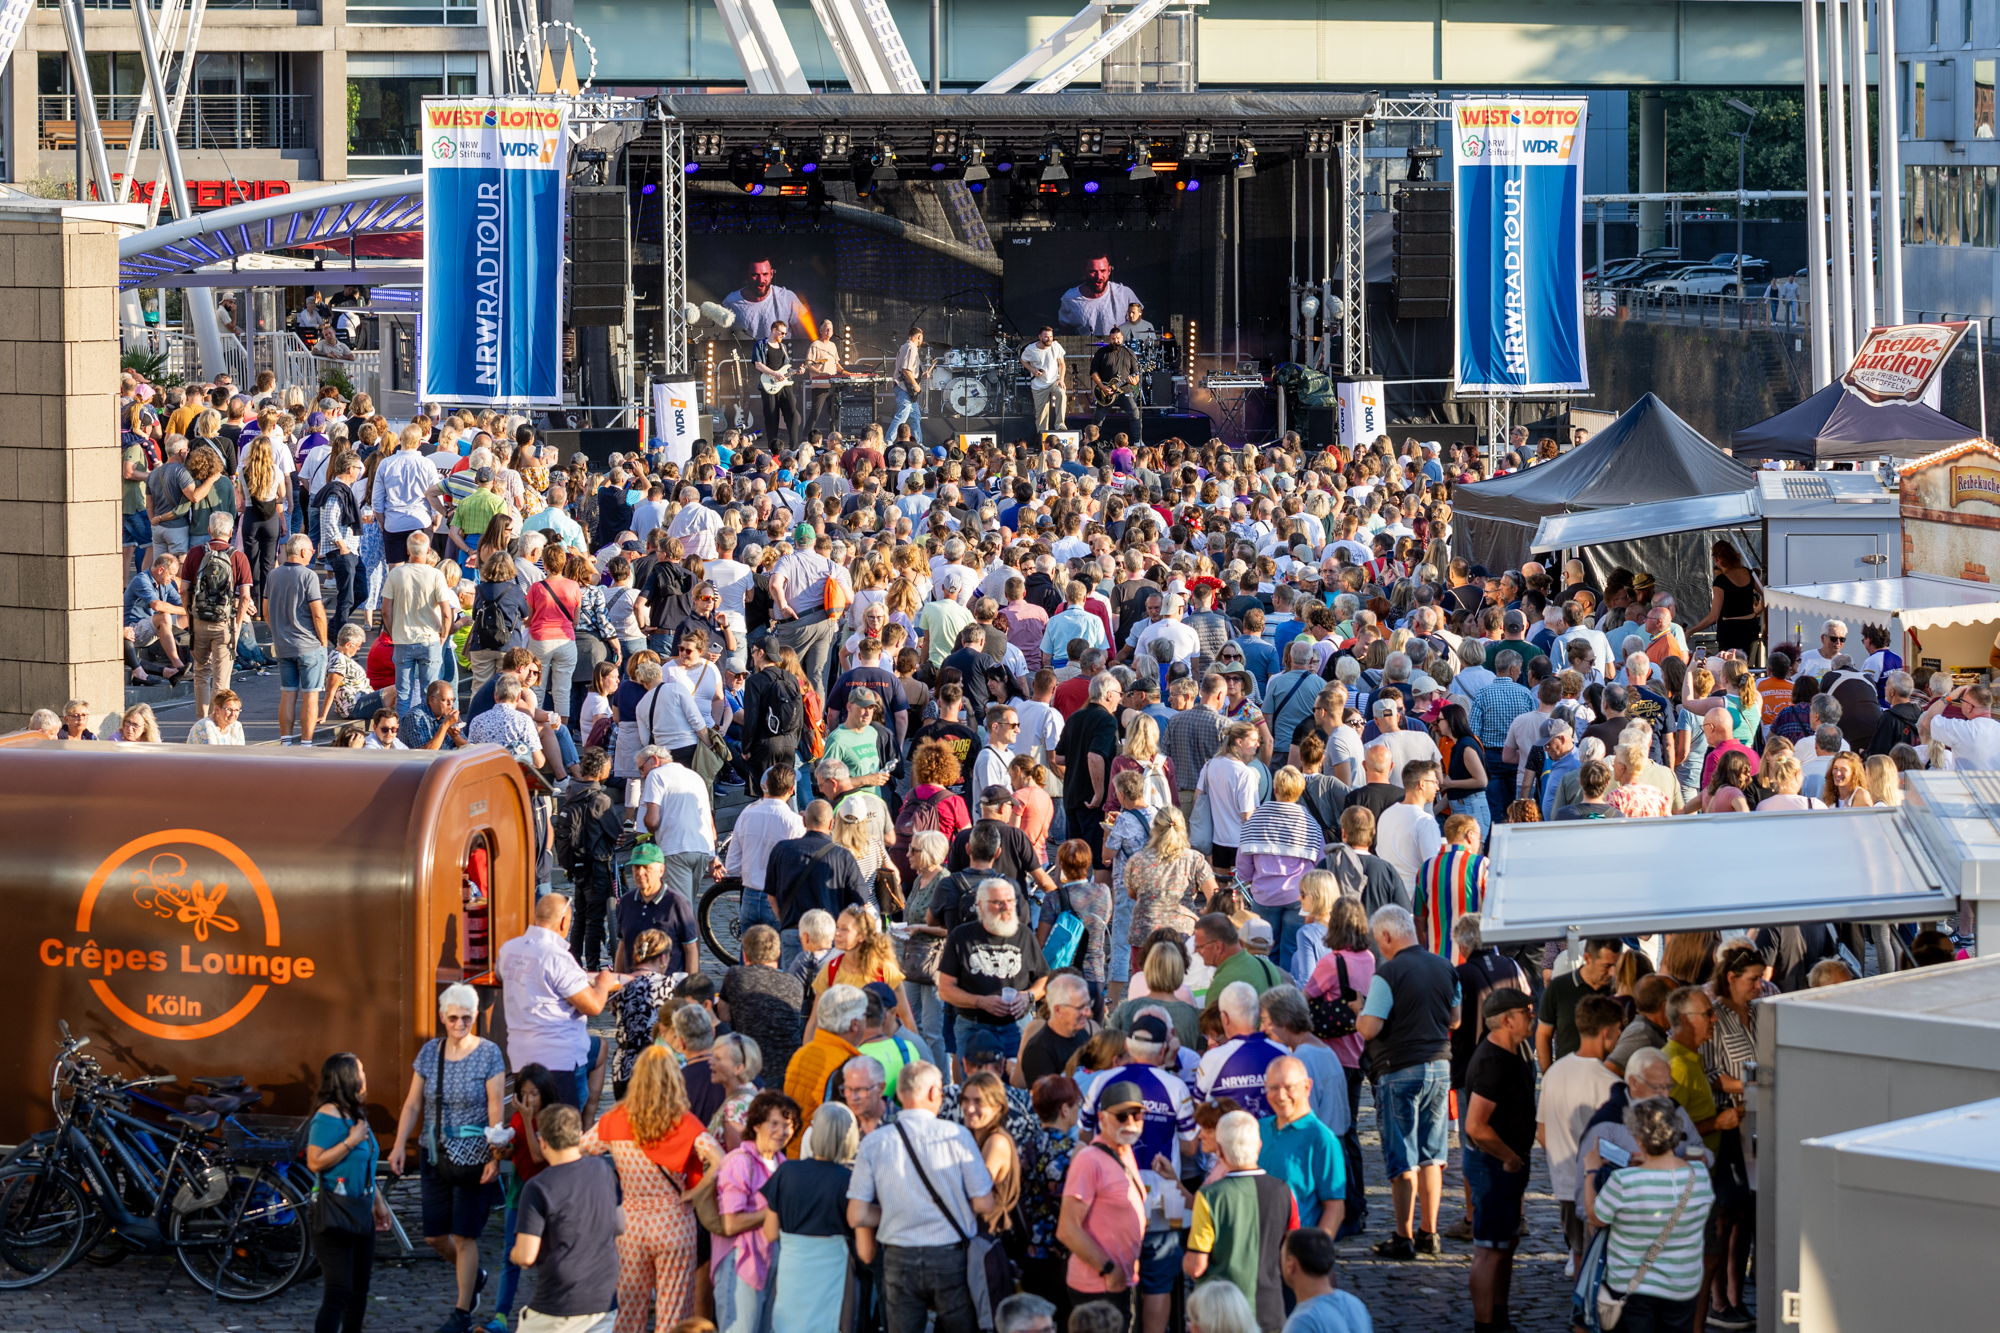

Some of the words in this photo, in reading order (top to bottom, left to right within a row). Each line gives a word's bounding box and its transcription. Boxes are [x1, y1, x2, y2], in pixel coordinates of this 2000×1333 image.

[431, 110, 484, 127] WEST
[500, 111, 560, 128] LOTTO
[1461, 109, 1510, 125] WEST
[1523, 110, 1578, 125] LOTTO
[459, 141, 479, 149] NRW
[499, 142, 539, 157] WDR
[1522, 139, 1559, 153] WDR
[459, 149, 492, 160] Stiftung
[474, 182, 500, 386] NRWRADTOUR
[1503, 178, 1526, 375] NRWRADTOUR
[1873, 336, 1942, 355] Reibe-
[1859, 375, 1907, 392] KARTOFFELN
[1876, 371, 1913, 386] FRISCHEN
[674, 408, 686, 437] WDR
[1364, 406, 1375, 433] WDR
[1957, 473, 2000, 495] Reibekuche
[39, 938, 168, 976] Crêpes
[180, 944, 315, 984] Lounge
[146, 994, 201, 1016] Köln
[1141, 1100, 1170, 1114] TOUR
[85, 1167, 104, 1196] Gazelle
